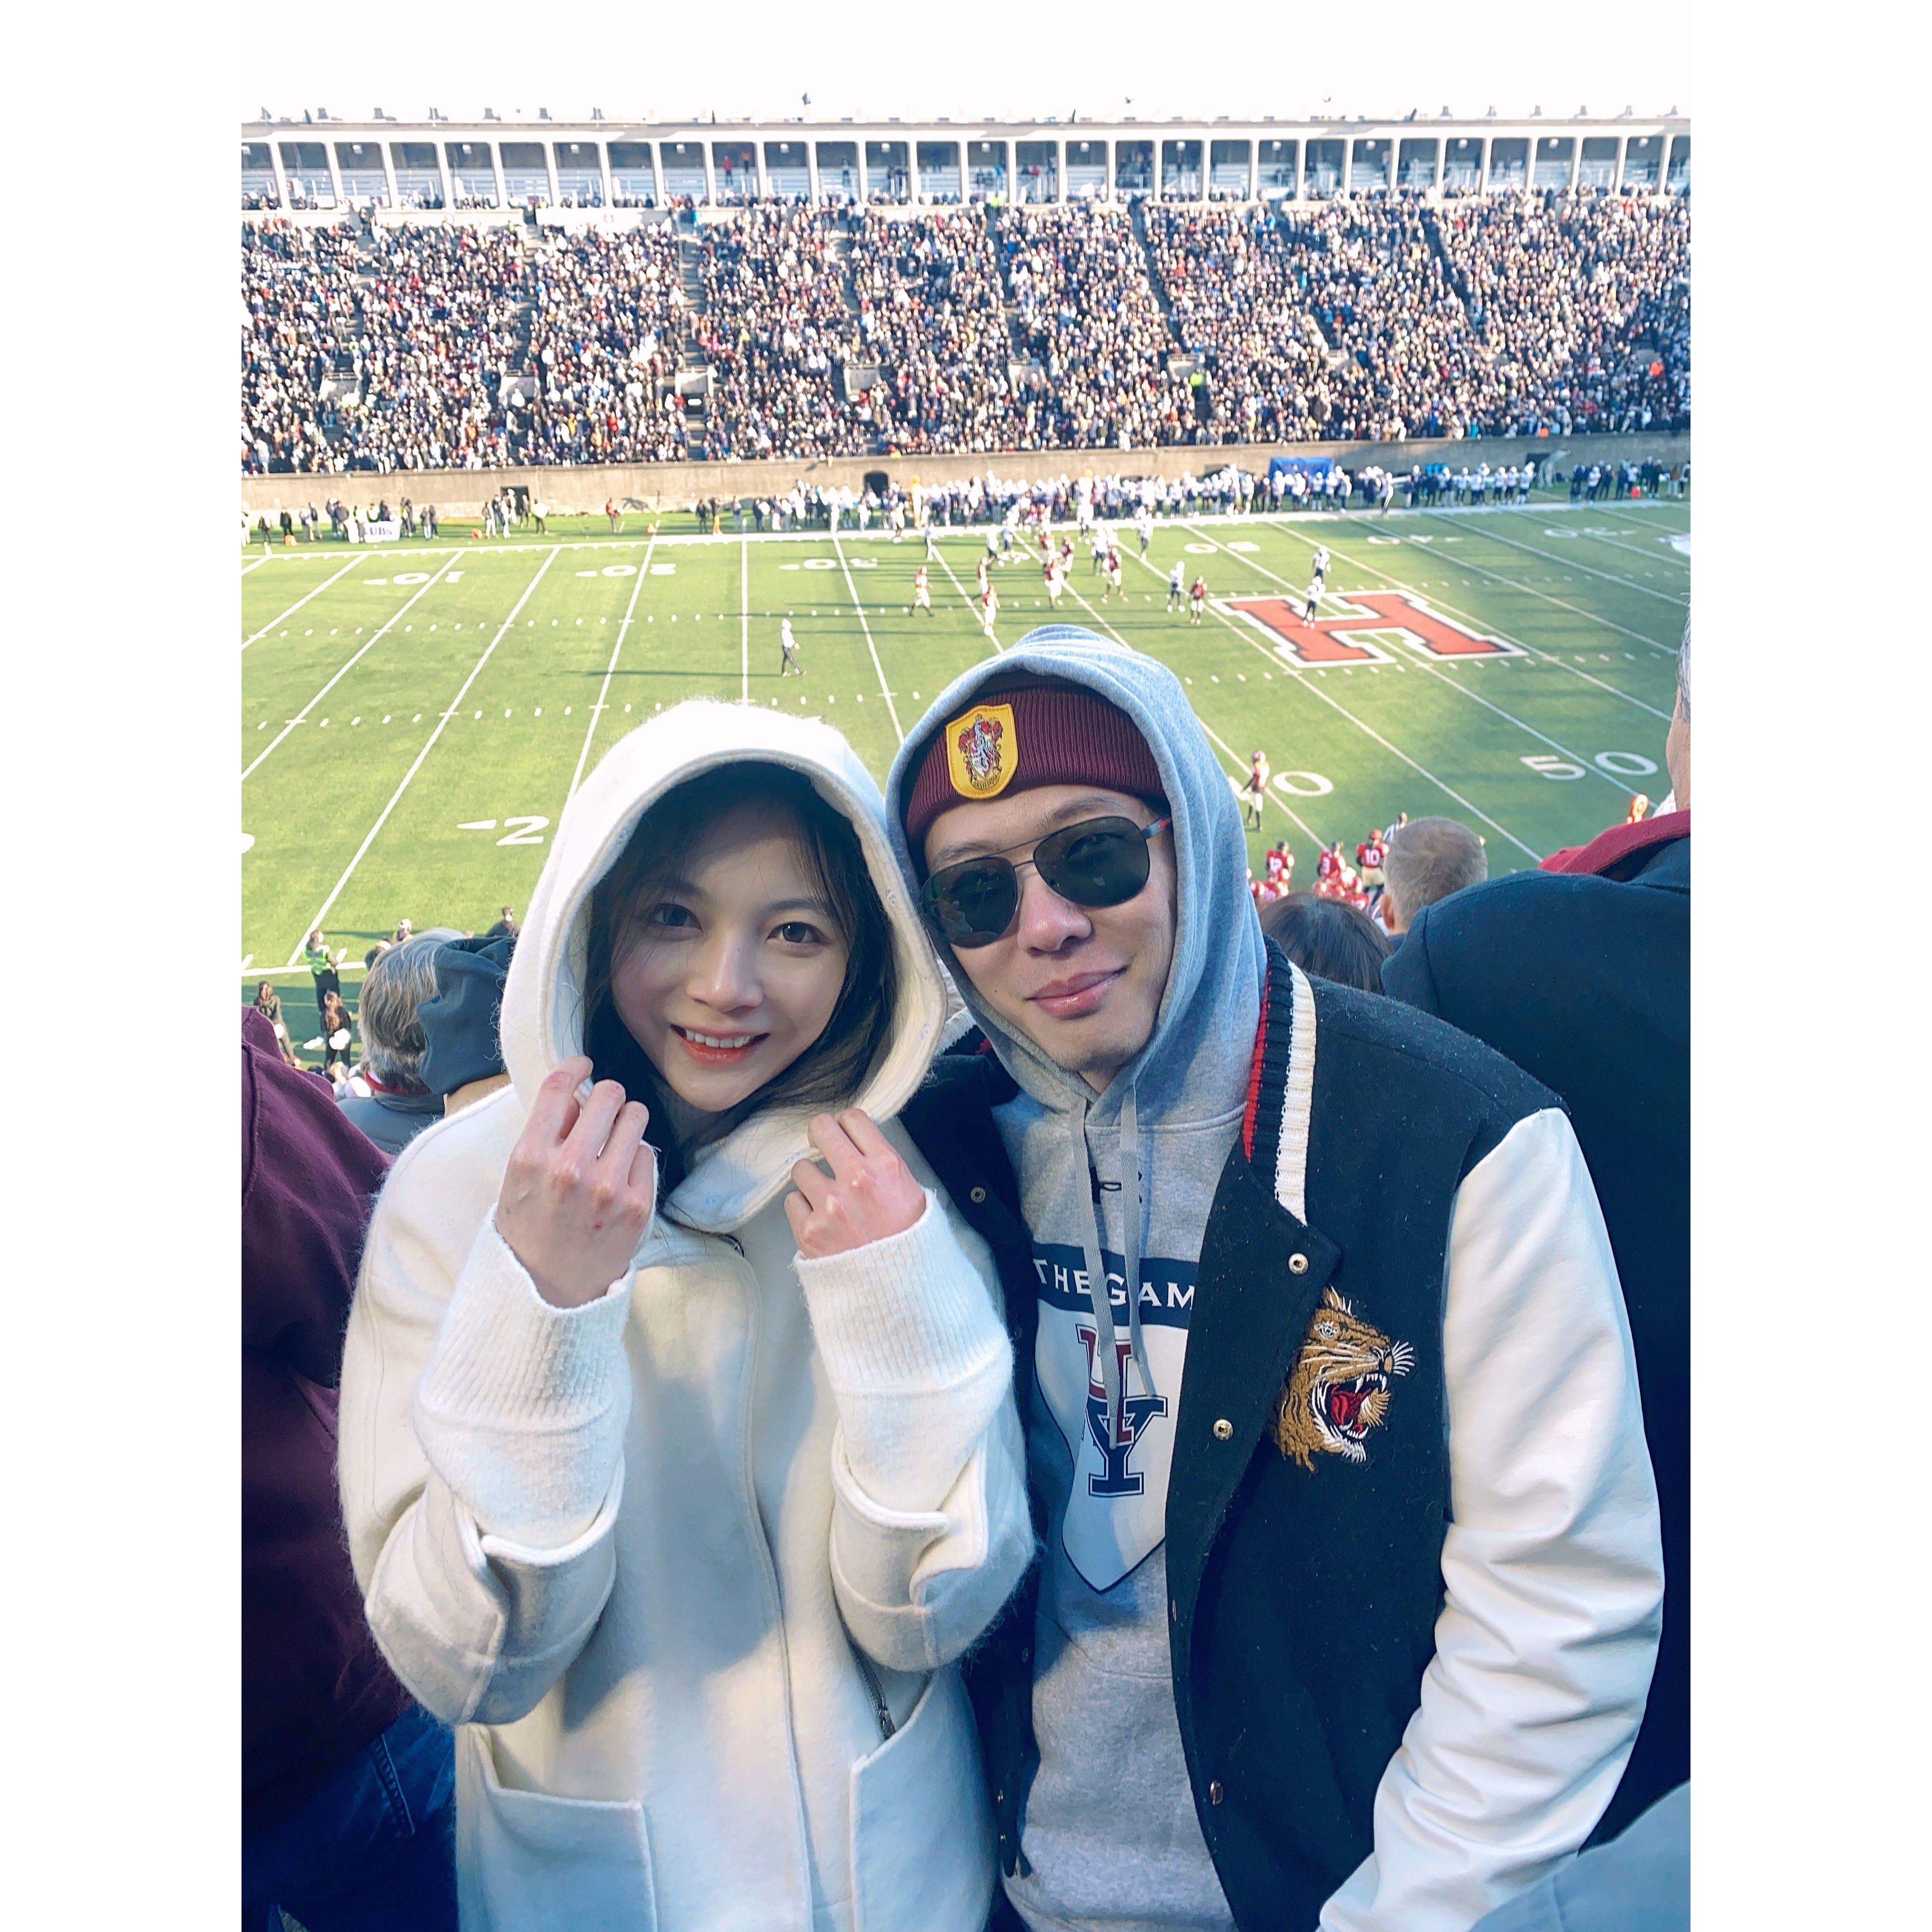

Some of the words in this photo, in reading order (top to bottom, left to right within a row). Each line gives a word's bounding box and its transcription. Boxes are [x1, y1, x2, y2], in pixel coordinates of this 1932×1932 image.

[1208, 589, 1528, 668] H
[1519, 751, 1658, 780] 50
[1364, 849, 1381, 866] 10
[1032, 1258, 1091, 1295] THE
